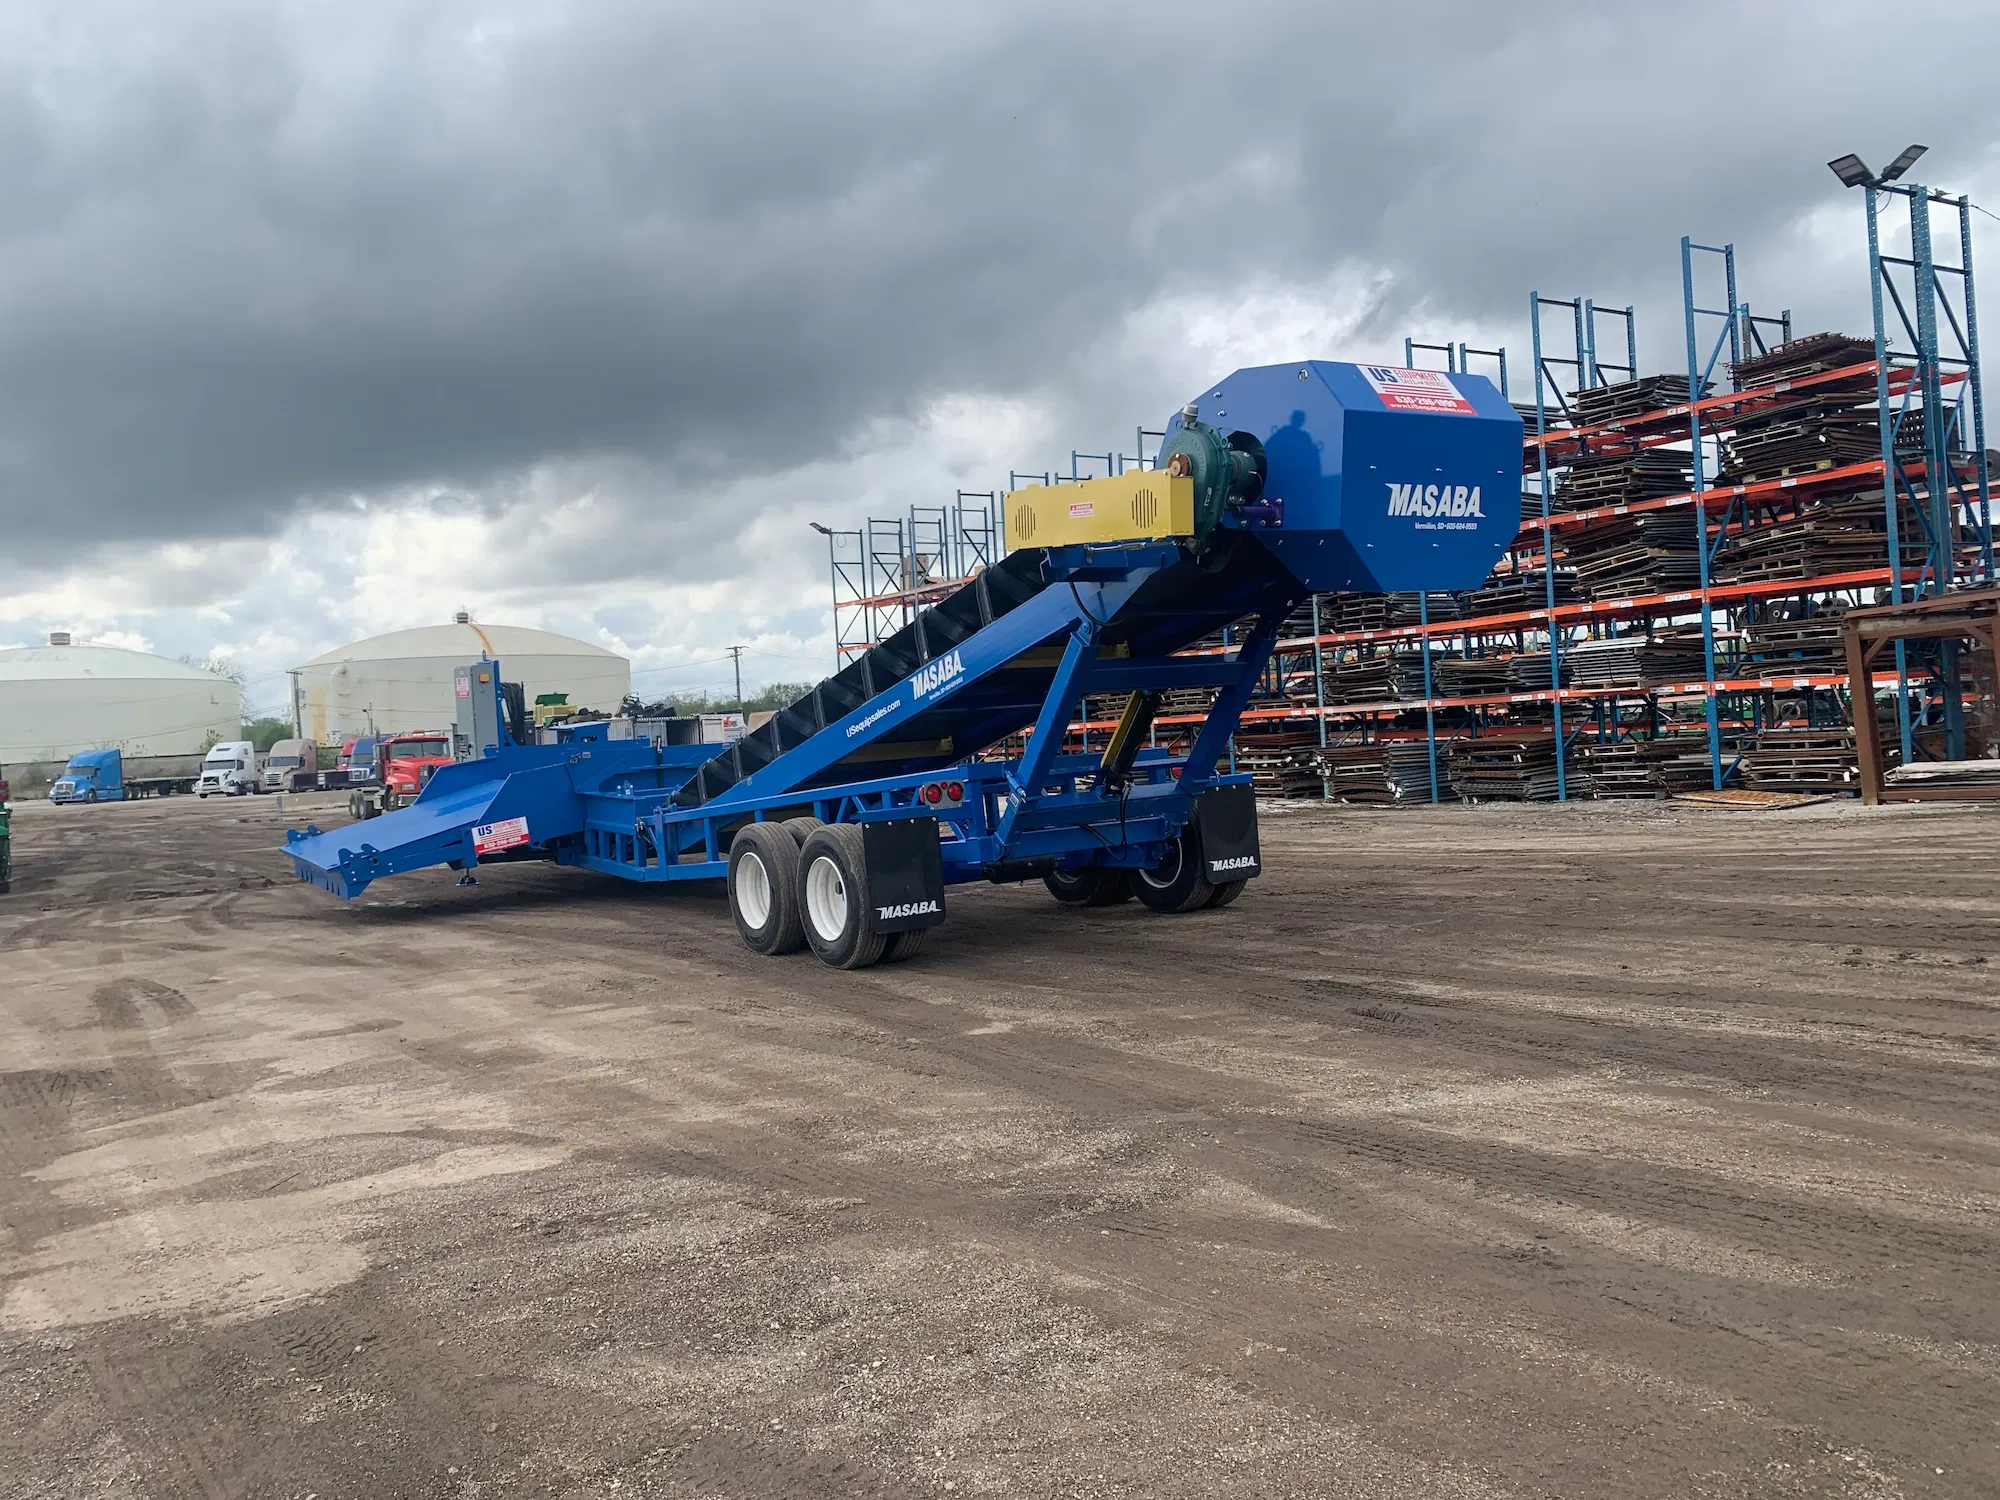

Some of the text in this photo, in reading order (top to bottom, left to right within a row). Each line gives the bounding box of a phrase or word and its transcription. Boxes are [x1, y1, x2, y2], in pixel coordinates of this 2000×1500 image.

[1367, 367, 1441, 383] US EQUIPMENT
[1385, 483, 1486, 517] MASABA
[909, 650, 966, 700] MASABA
[846, 699, 901, 738] USequipsales.com
[478, 825, 493, 836] US
[1209, 855, 1258, 871] MASABA
[875, 900, 942, 920] MASABA
